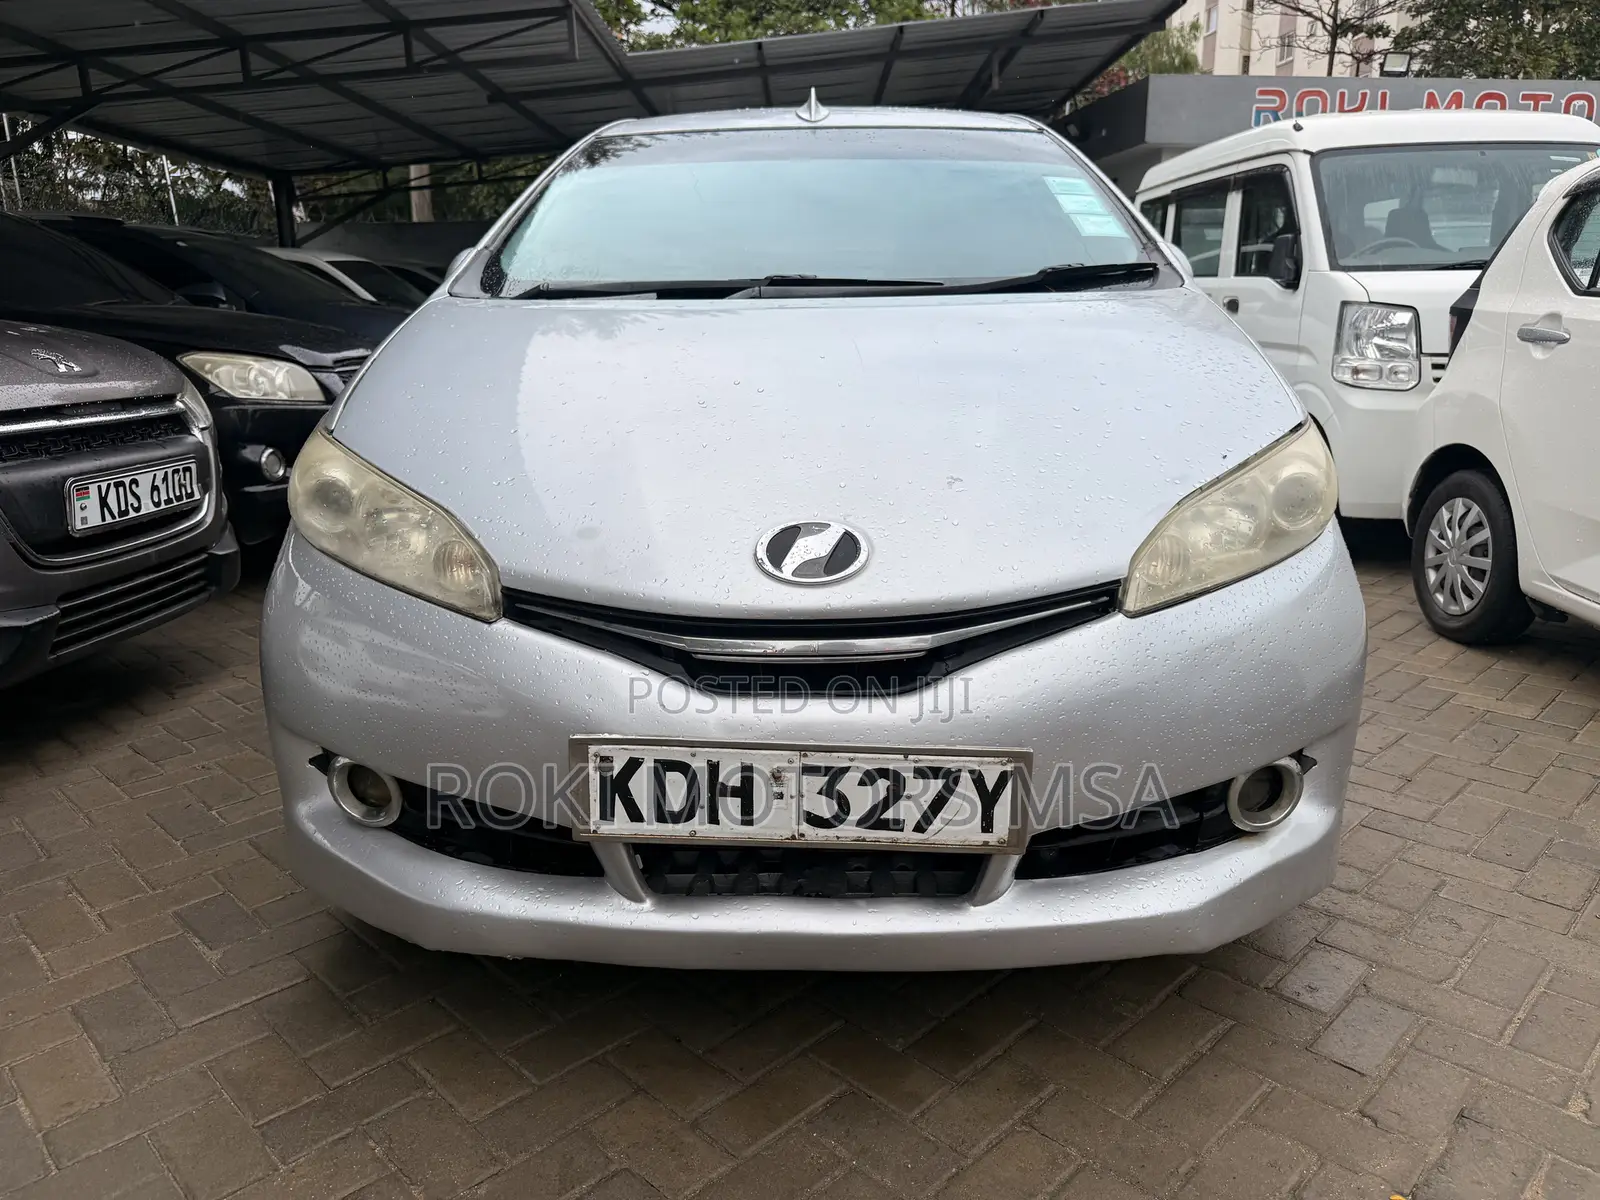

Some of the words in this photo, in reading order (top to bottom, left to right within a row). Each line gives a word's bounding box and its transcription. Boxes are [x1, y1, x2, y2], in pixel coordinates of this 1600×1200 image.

[97, 477, 142, 523] KDS
[599, 755, 755, 827] KDH
[800, 762, 1015, 834] 327Y
